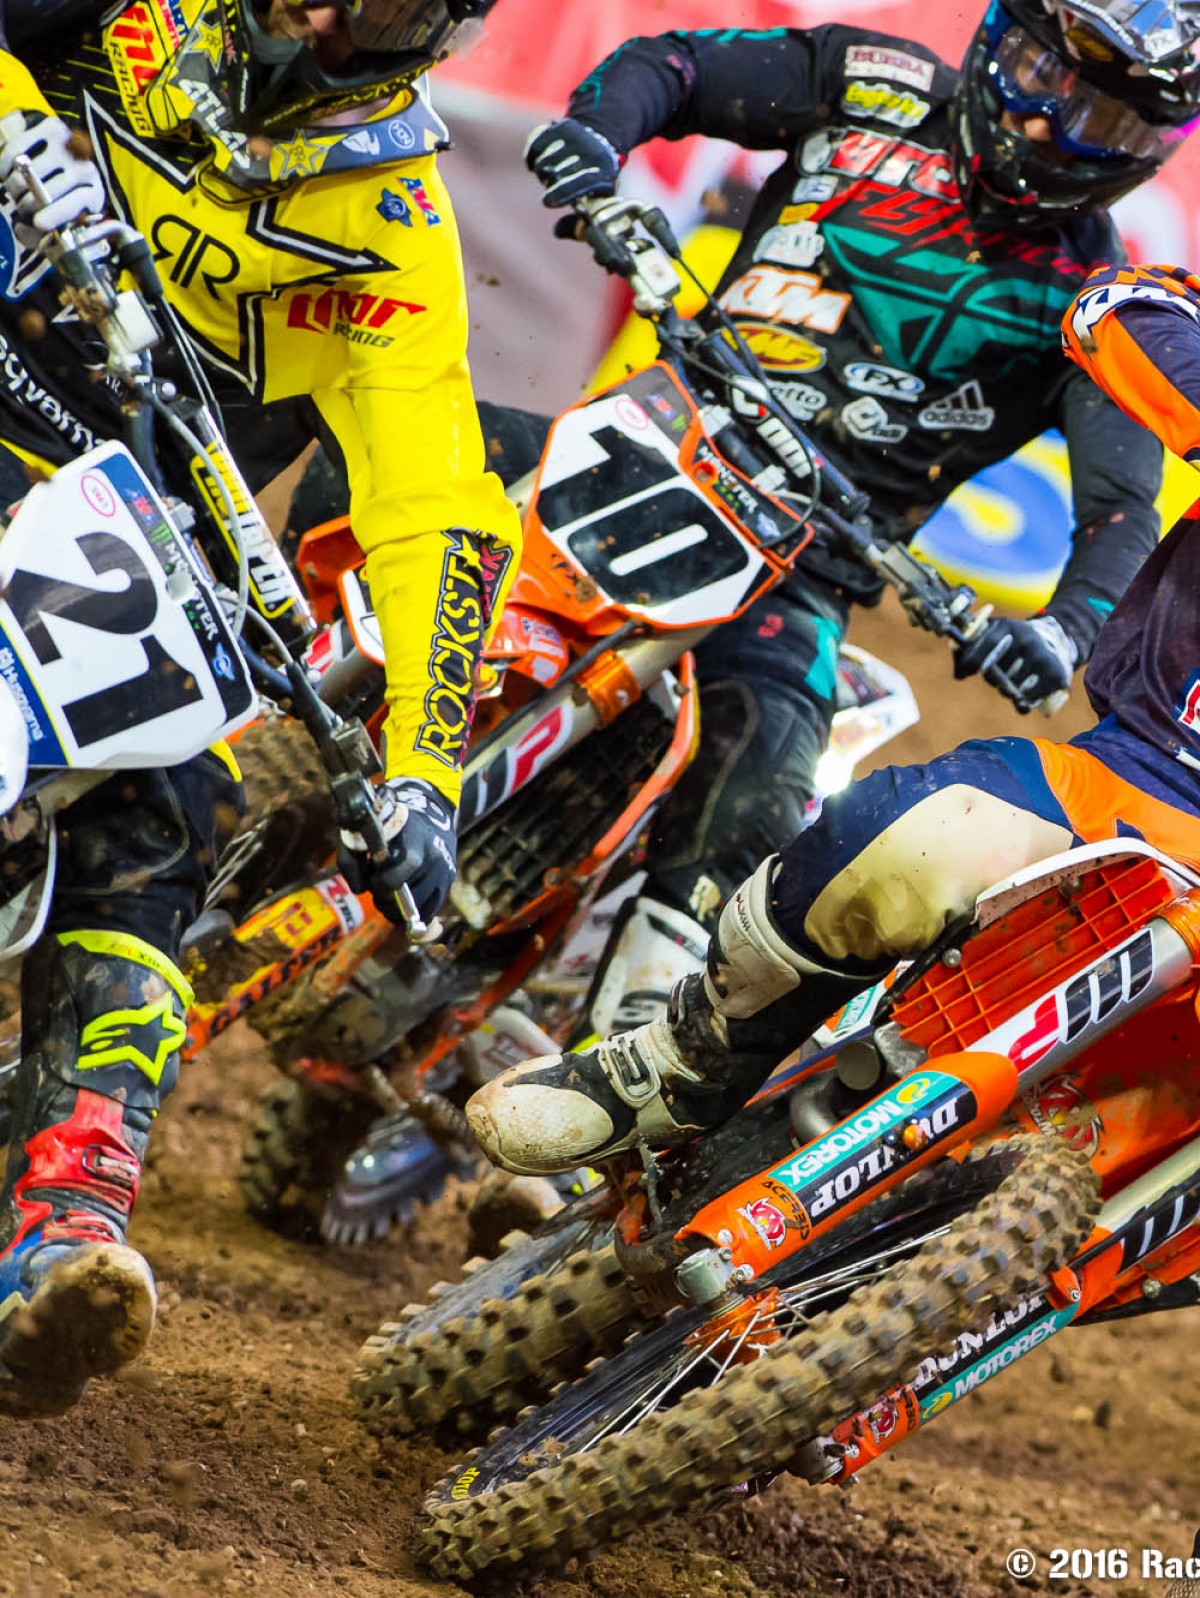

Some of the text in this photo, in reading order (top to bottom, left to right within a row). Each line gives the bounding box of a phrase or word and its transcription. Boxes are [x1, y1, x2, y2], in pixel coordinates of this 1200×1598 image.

[178, 78, 252, 170] ATLAS
[718, 264, 853, 335] KTM
[536, 424, 750, 608] 10
[4, 531, 205, 749] 21
[785, 1099, 902, 1185] MOTOREX
[953, 1315, 1059, 1401] MOTOREX
